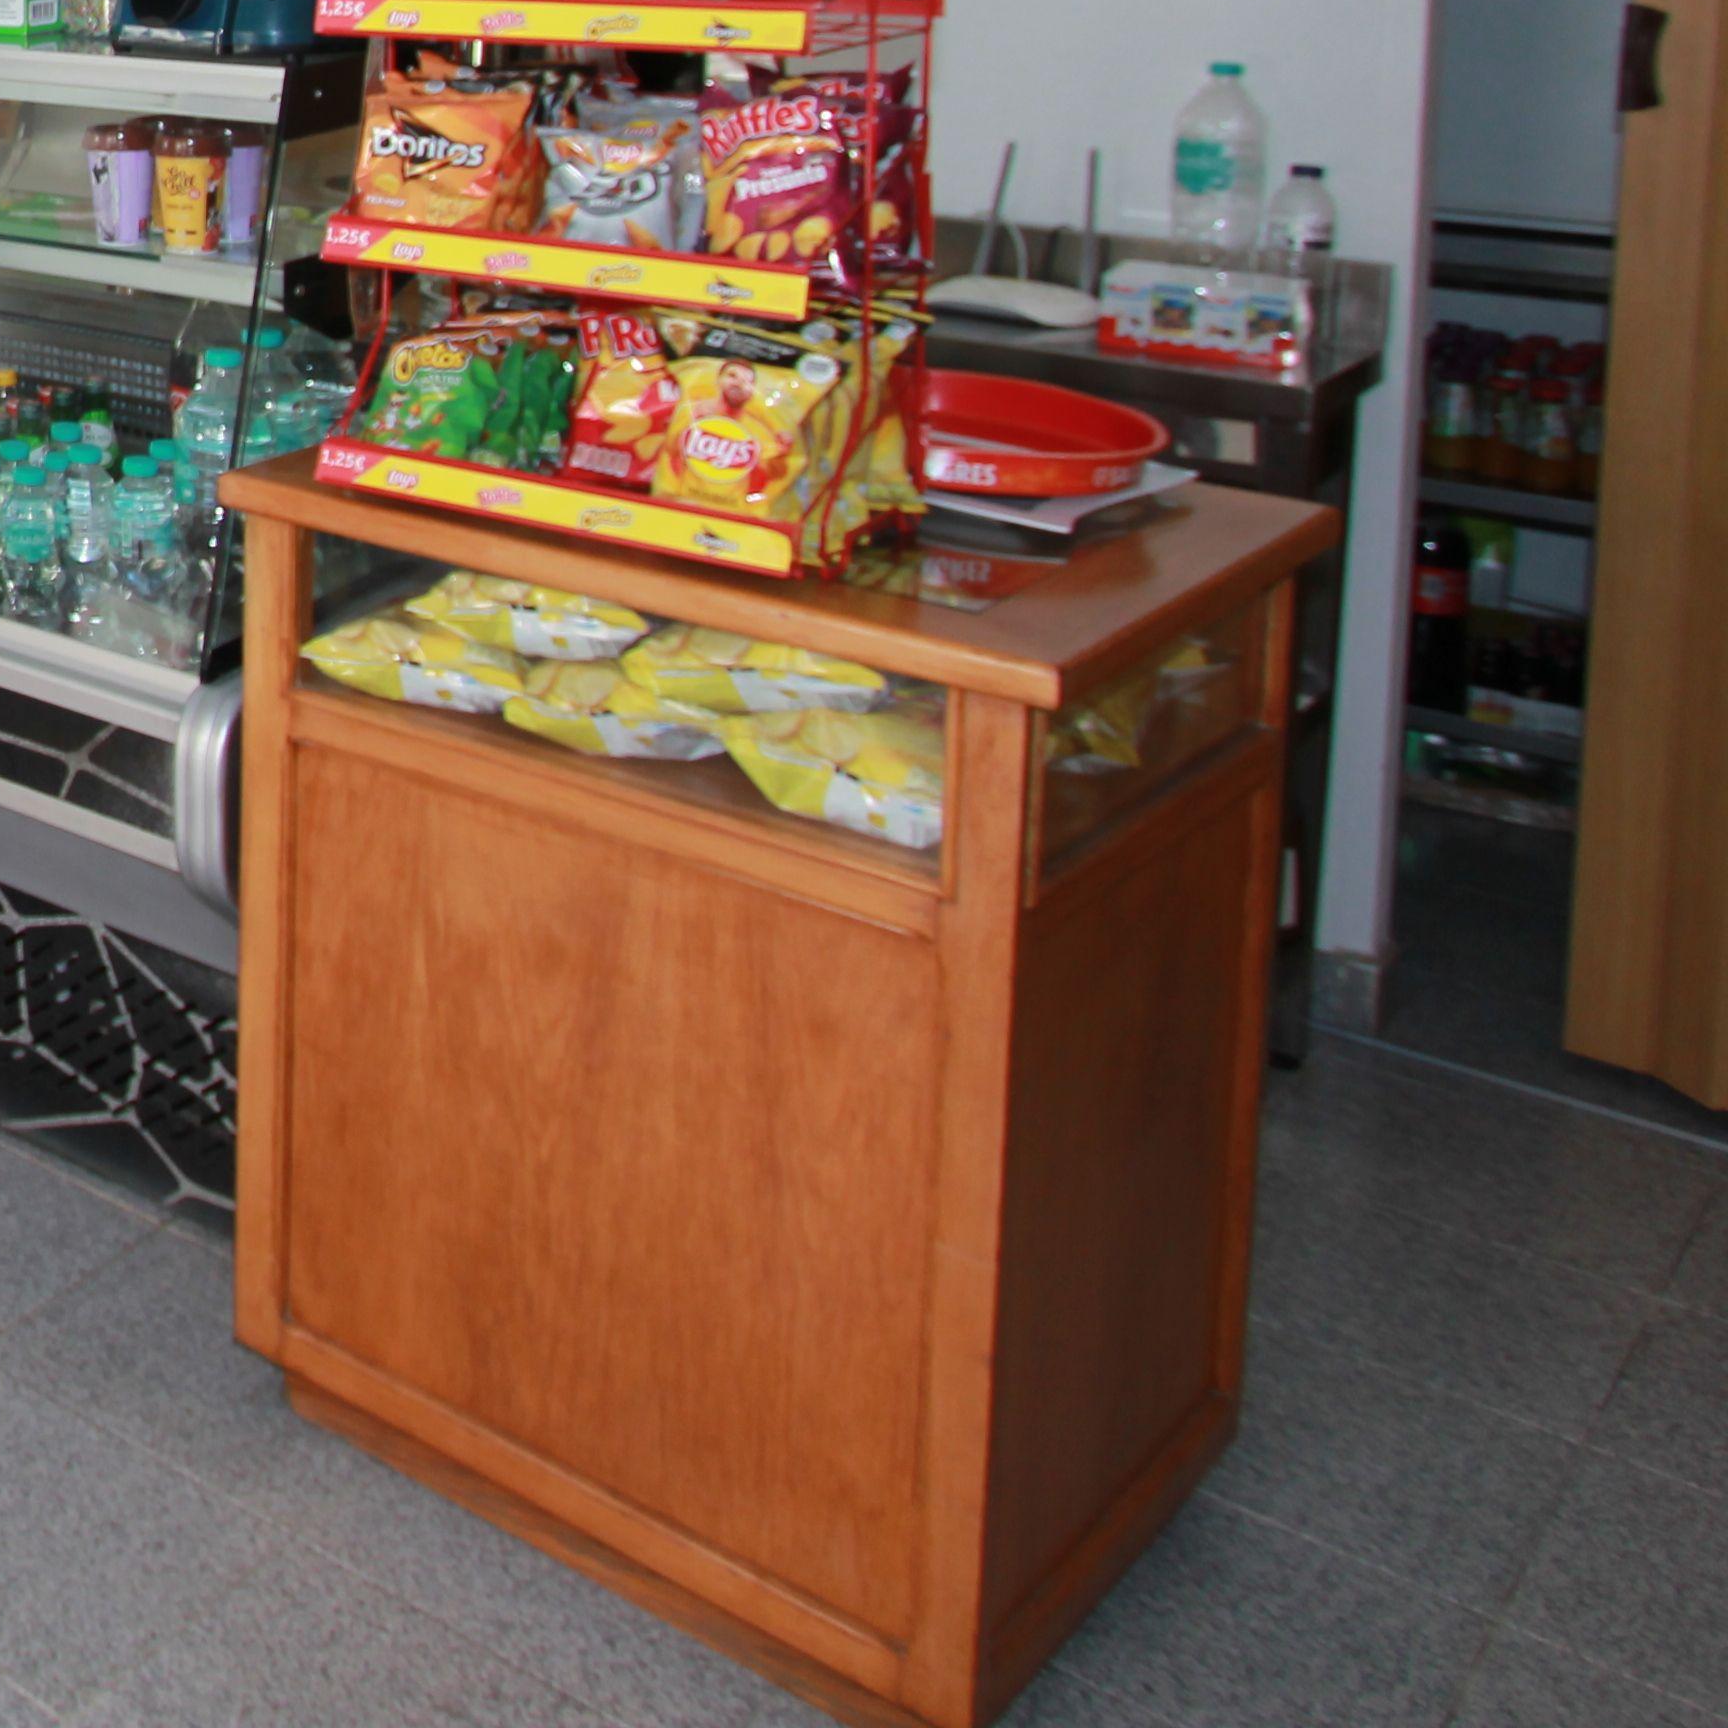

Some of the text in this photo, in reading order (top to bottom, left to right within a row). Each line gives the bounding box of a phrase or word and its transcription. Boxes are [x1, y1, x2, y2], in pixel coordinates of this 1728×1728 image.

[320, 0, 365, 17] 1,25€
[702, 97, 818, 161] Ruffles
[373, 126, 485, 166] Doritos
[325, 227, 370, 246] 1,25€
[320, 450, 366, 469] 1,25€
